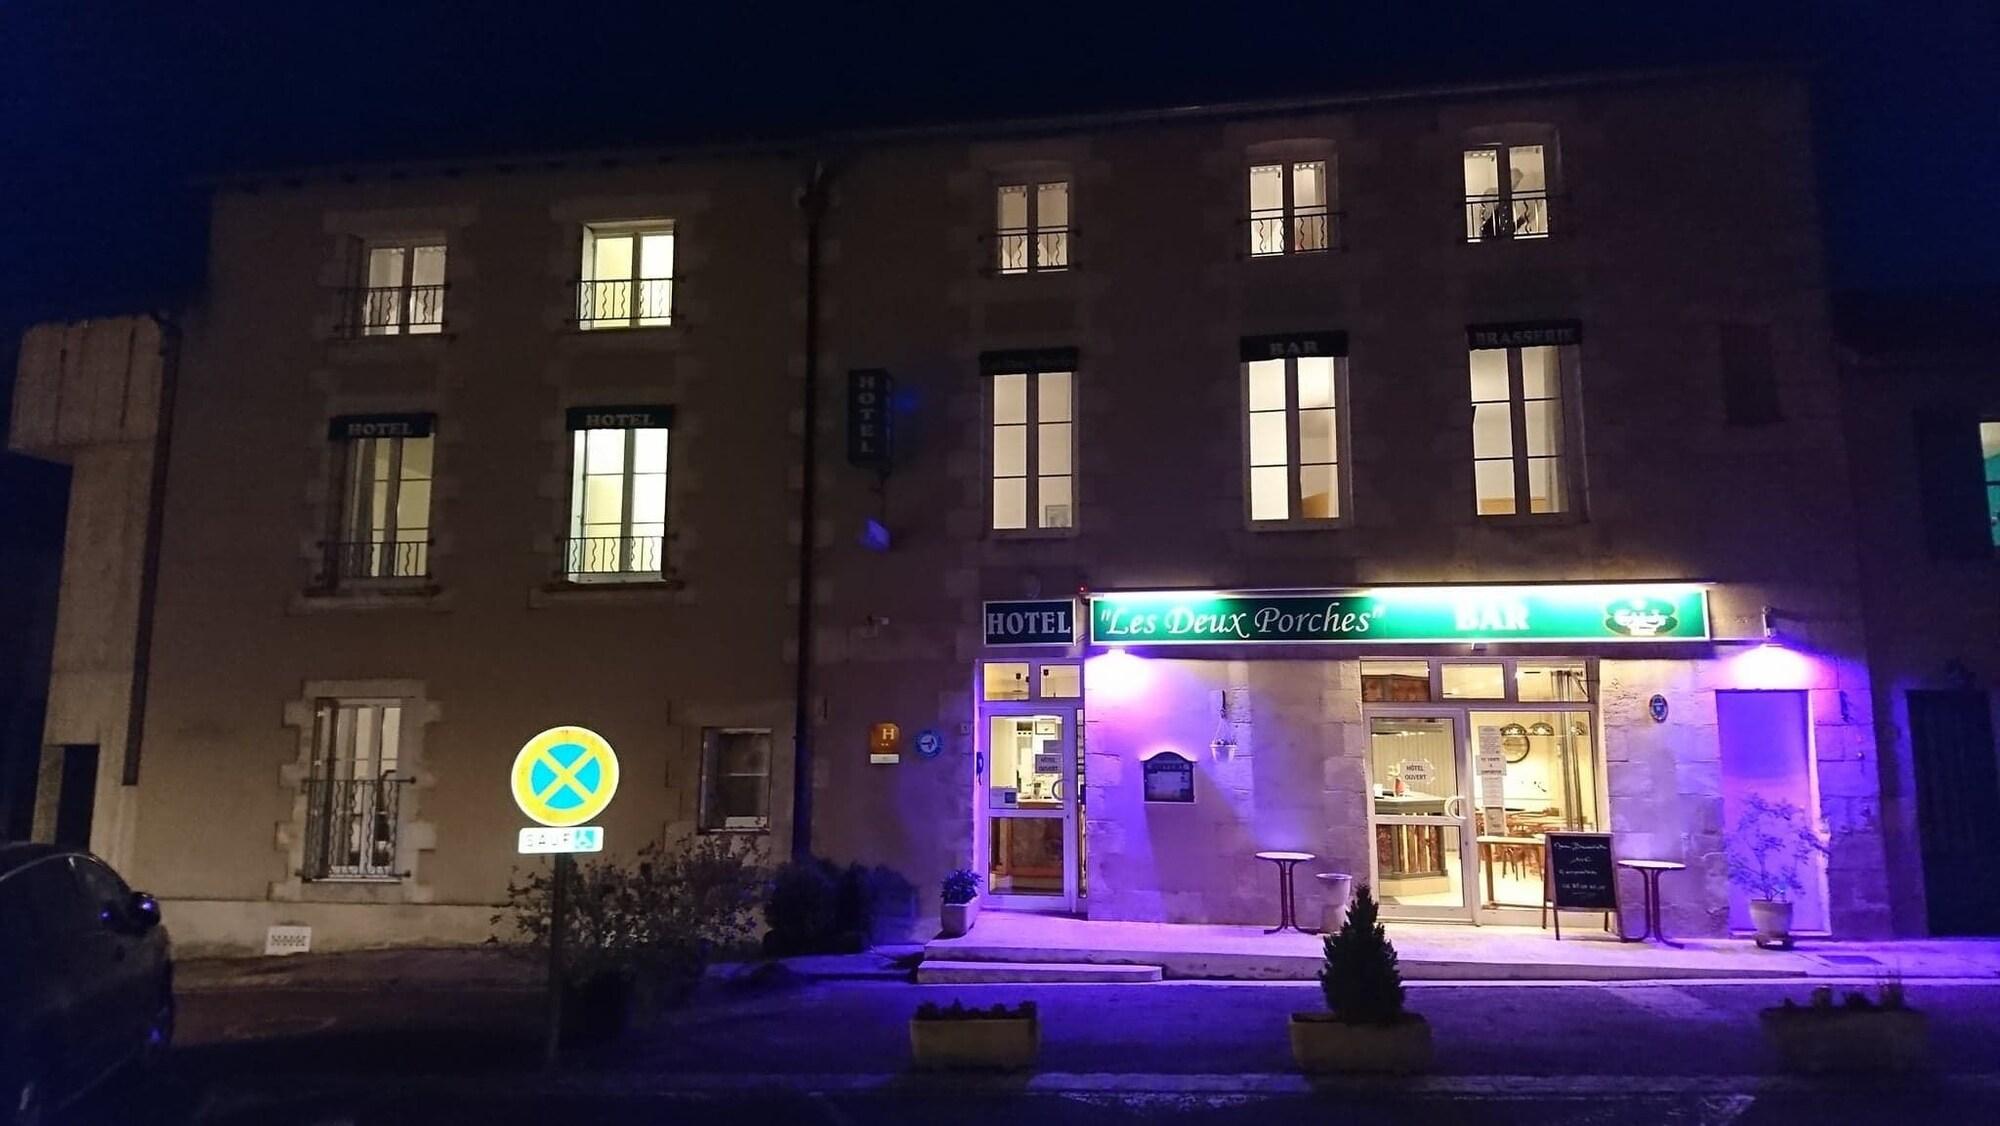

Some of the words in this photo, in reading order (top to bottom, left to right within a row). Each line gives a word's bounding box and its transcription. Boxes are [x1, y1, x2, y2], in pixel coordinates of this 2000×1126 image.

[1270, 340, 1320, 355] BAR
[1475, 327, 1574, 346] BRASSERIE
[586, 413, 655, 426] HOTEL
[858, 375, 876, 453] HOTEL
[348, 422, 414, 436] HOTEL
[986, 610, 1072, 635] HOTEL
[1100, 606, 1156, 635] "Les
[1163, 605, 1250, 639] Deux
[1254, 602, 1386, 633] Porches"
[1454, 597, 1531, 630] BAR
